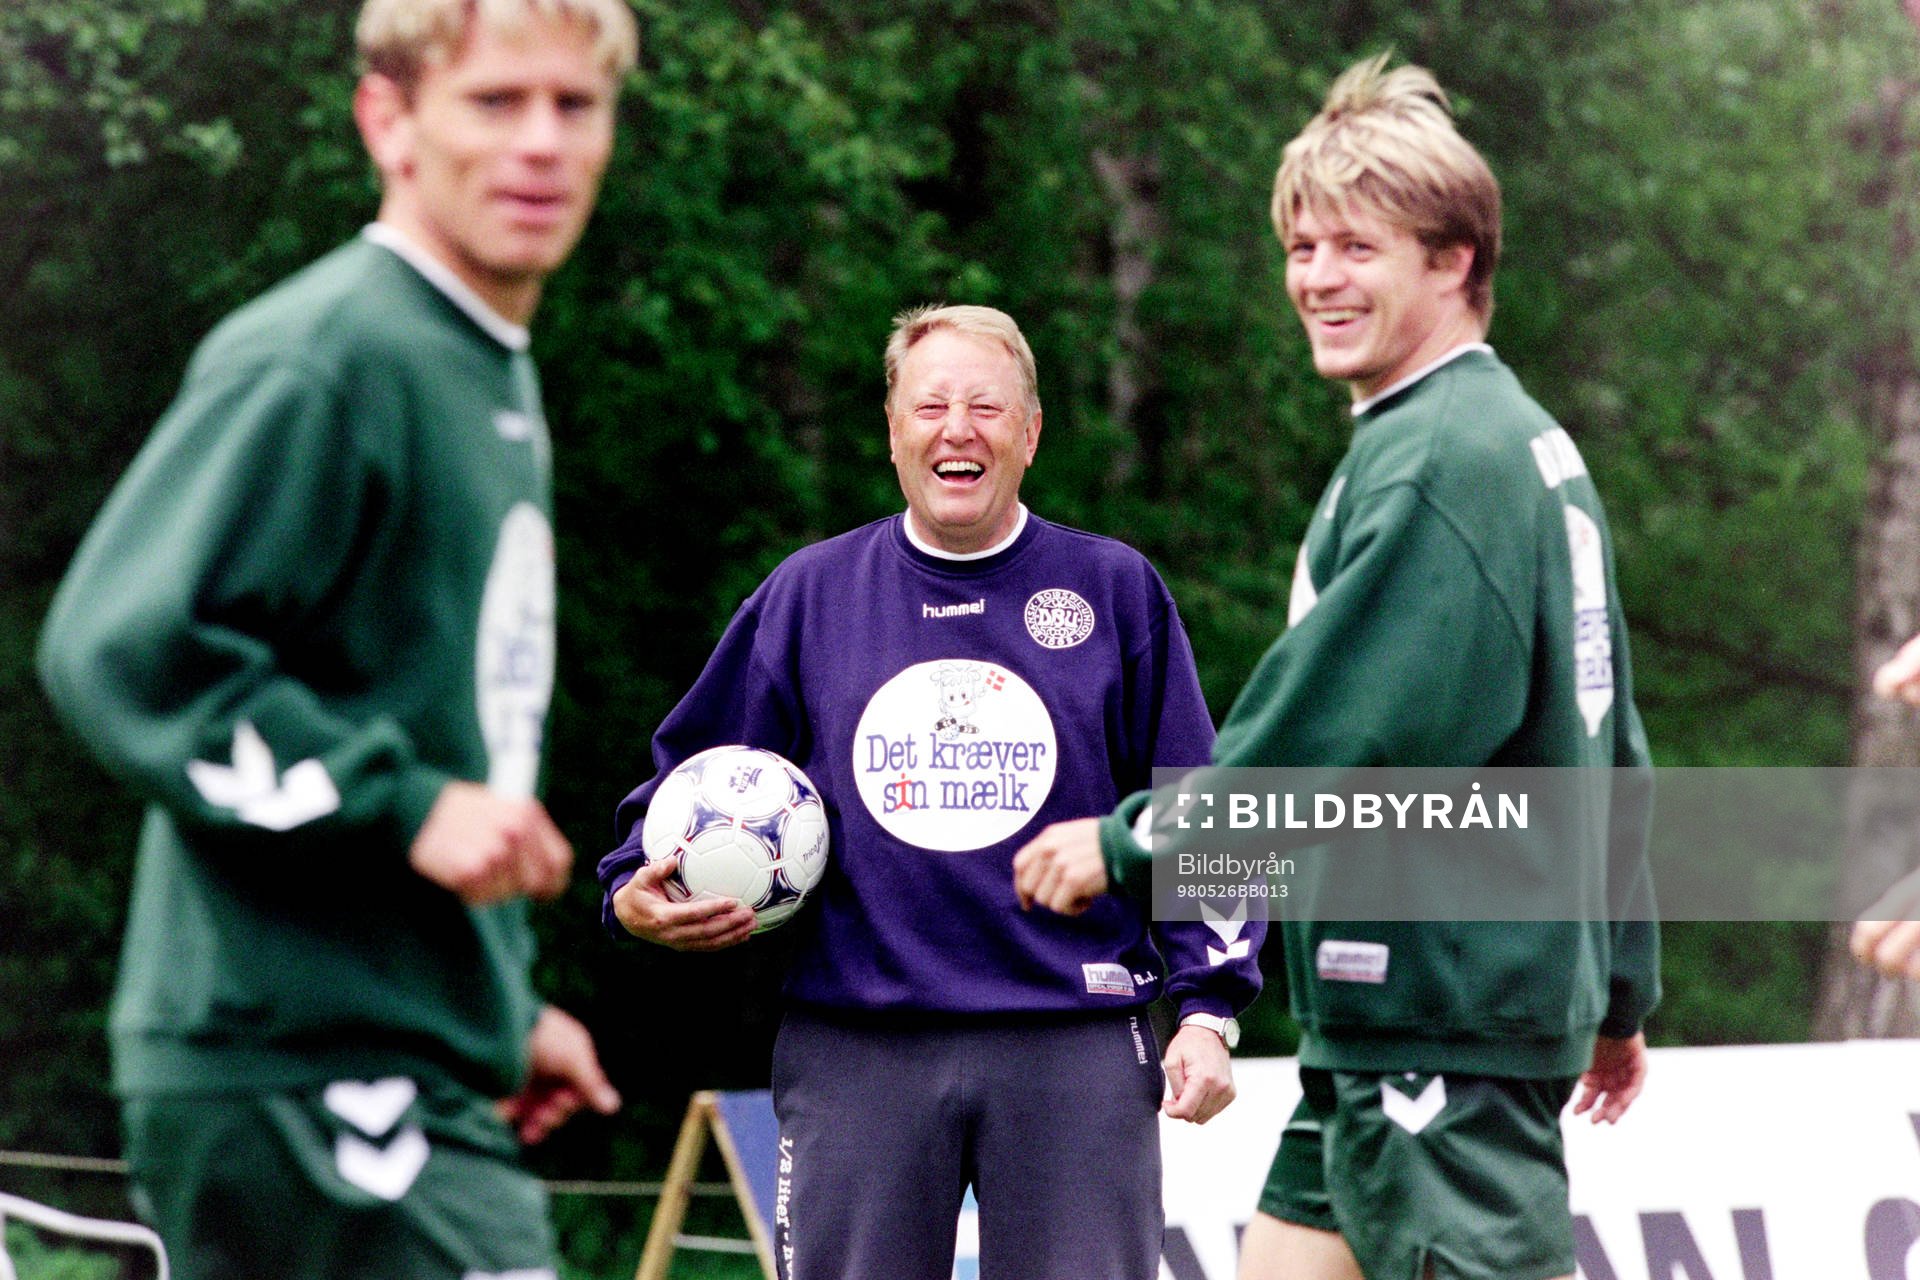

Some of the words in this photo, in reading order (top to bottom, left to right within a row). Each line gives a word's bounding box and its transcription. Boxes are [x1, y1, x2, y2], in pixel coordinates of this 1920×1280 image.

[922, 598, 985, 618] hummel
[1037, 608, 1080, 628] DBU
[865, 733, 918, 773] Det
[928, 732, 1046, 772] kræver
[883, 772, 930, 815] sin
[939, 772, 1030, 812] mælk
[1133, 970, 1158, 986] B.J.
[779, 1136, 793, 1174] 1/2
[776, 1177, 792, 1228] liter
